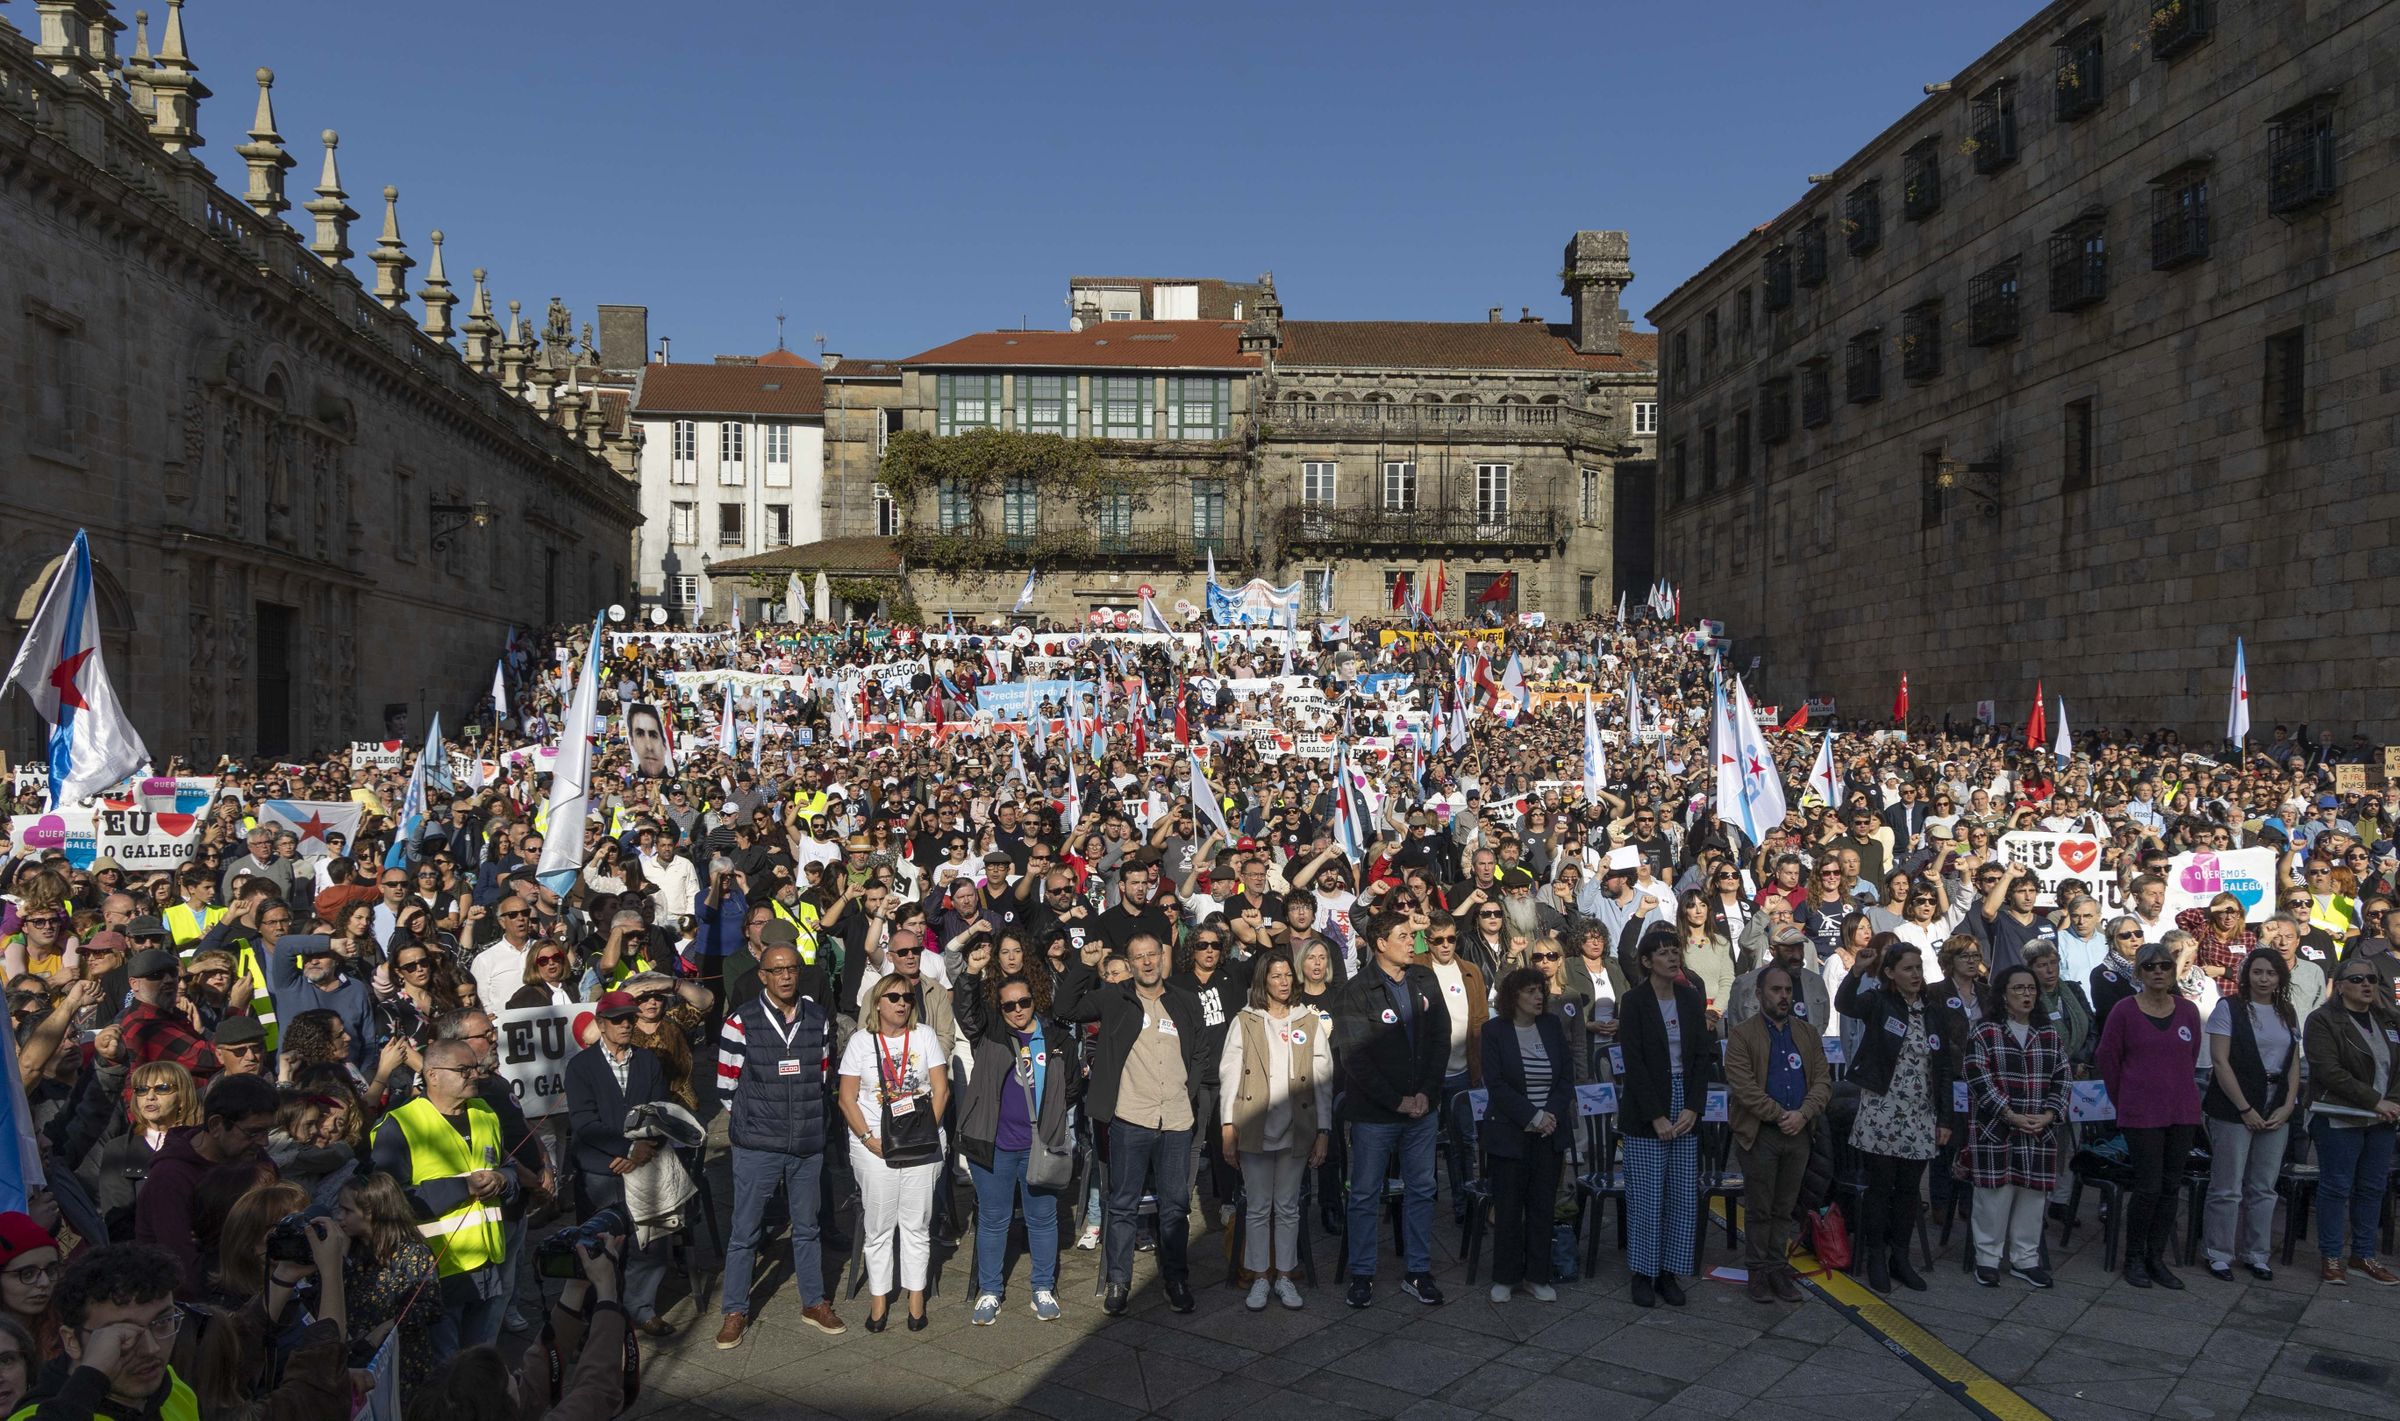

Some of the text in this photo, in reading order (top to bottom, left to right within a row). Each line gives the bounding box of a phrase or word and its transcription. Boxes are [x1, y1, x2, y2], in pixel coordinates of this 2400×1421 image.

[877, 663, 917, 679] GALEGO
[989, 689, 1045, 700] Precisaos
[1258, 740, 1276, 750] EU
[366, 756, 401, 764] GALEGO
[102, 810, 152, 836] EU
[38, 830, 92, 839] QUEREMOS
[66, 841, 97, 850] GALEG
[104, 843, 195, 860] O GALEGO
[2004, 839, 2056, 870] EU
[2194, 870, 2247, 881] QUEREMOS
[2223, 881, 2262, 892] GALEGO
[502, 1016, 568, 1064] EU
[510, 1078, 526, 1099] O
